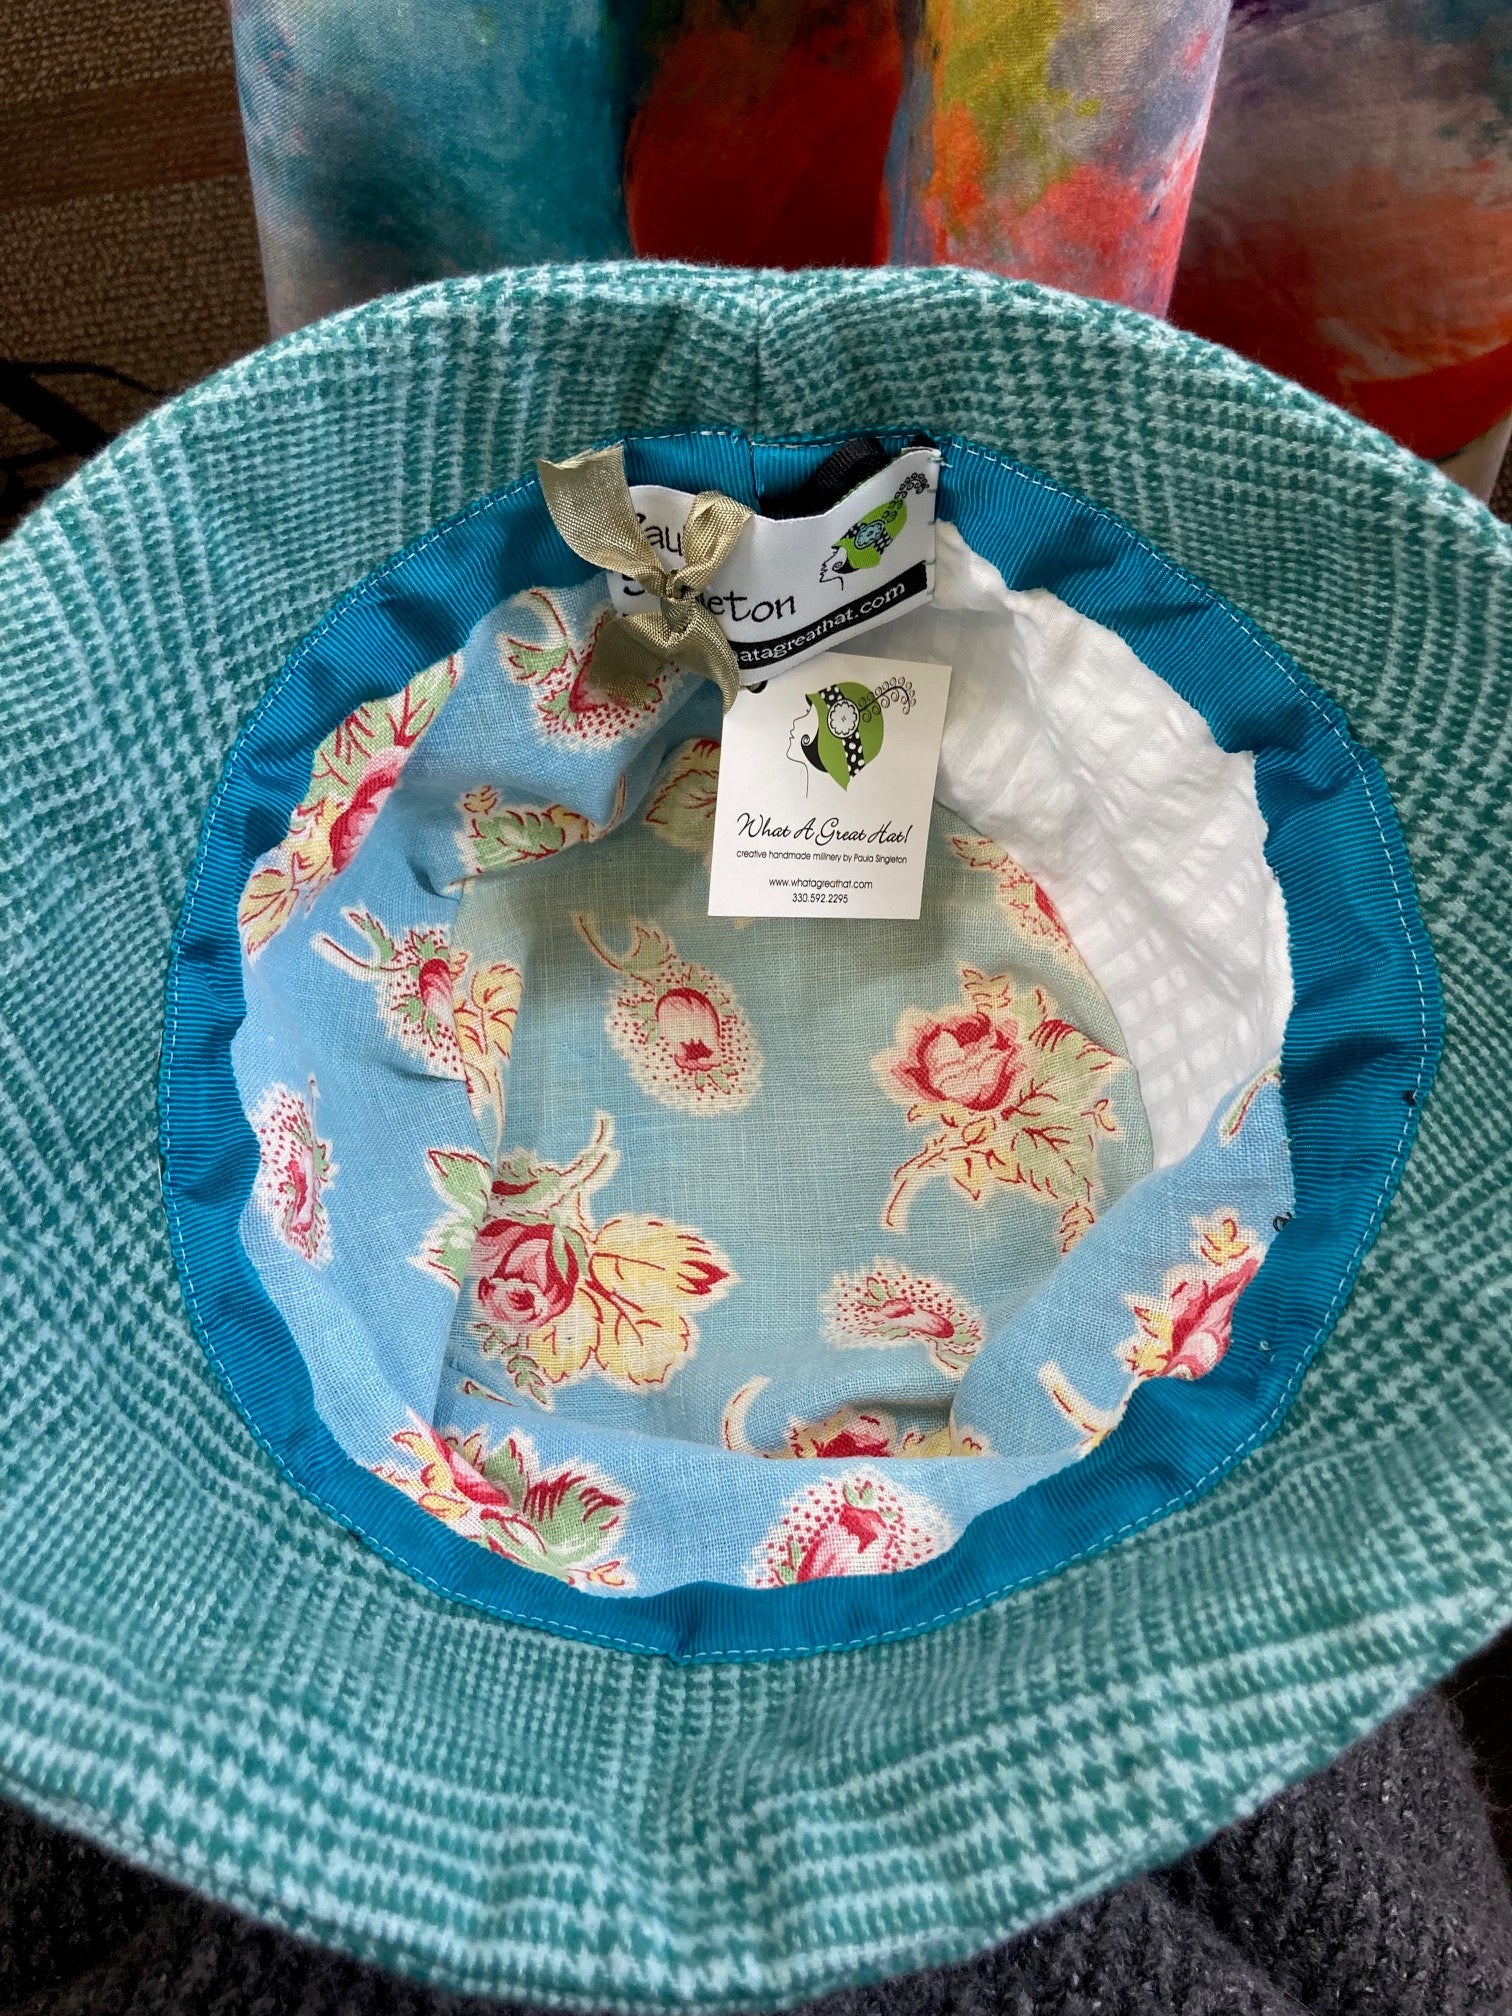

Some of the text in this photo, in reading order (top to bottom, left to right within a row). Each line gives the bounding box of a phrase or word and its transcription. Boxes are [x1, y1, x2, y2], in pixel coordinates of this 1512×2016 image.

[738, 581, 906, 662] atagreathat.com
[736, 812, 914, 846] What A Great Hat!
[736, 849, 908, 866] creative handmade millinery by Paula Singleton
[768, 877, 873, 890] www.whatagreathat.com
[791, 892, 849, 904] 330.592.2295
